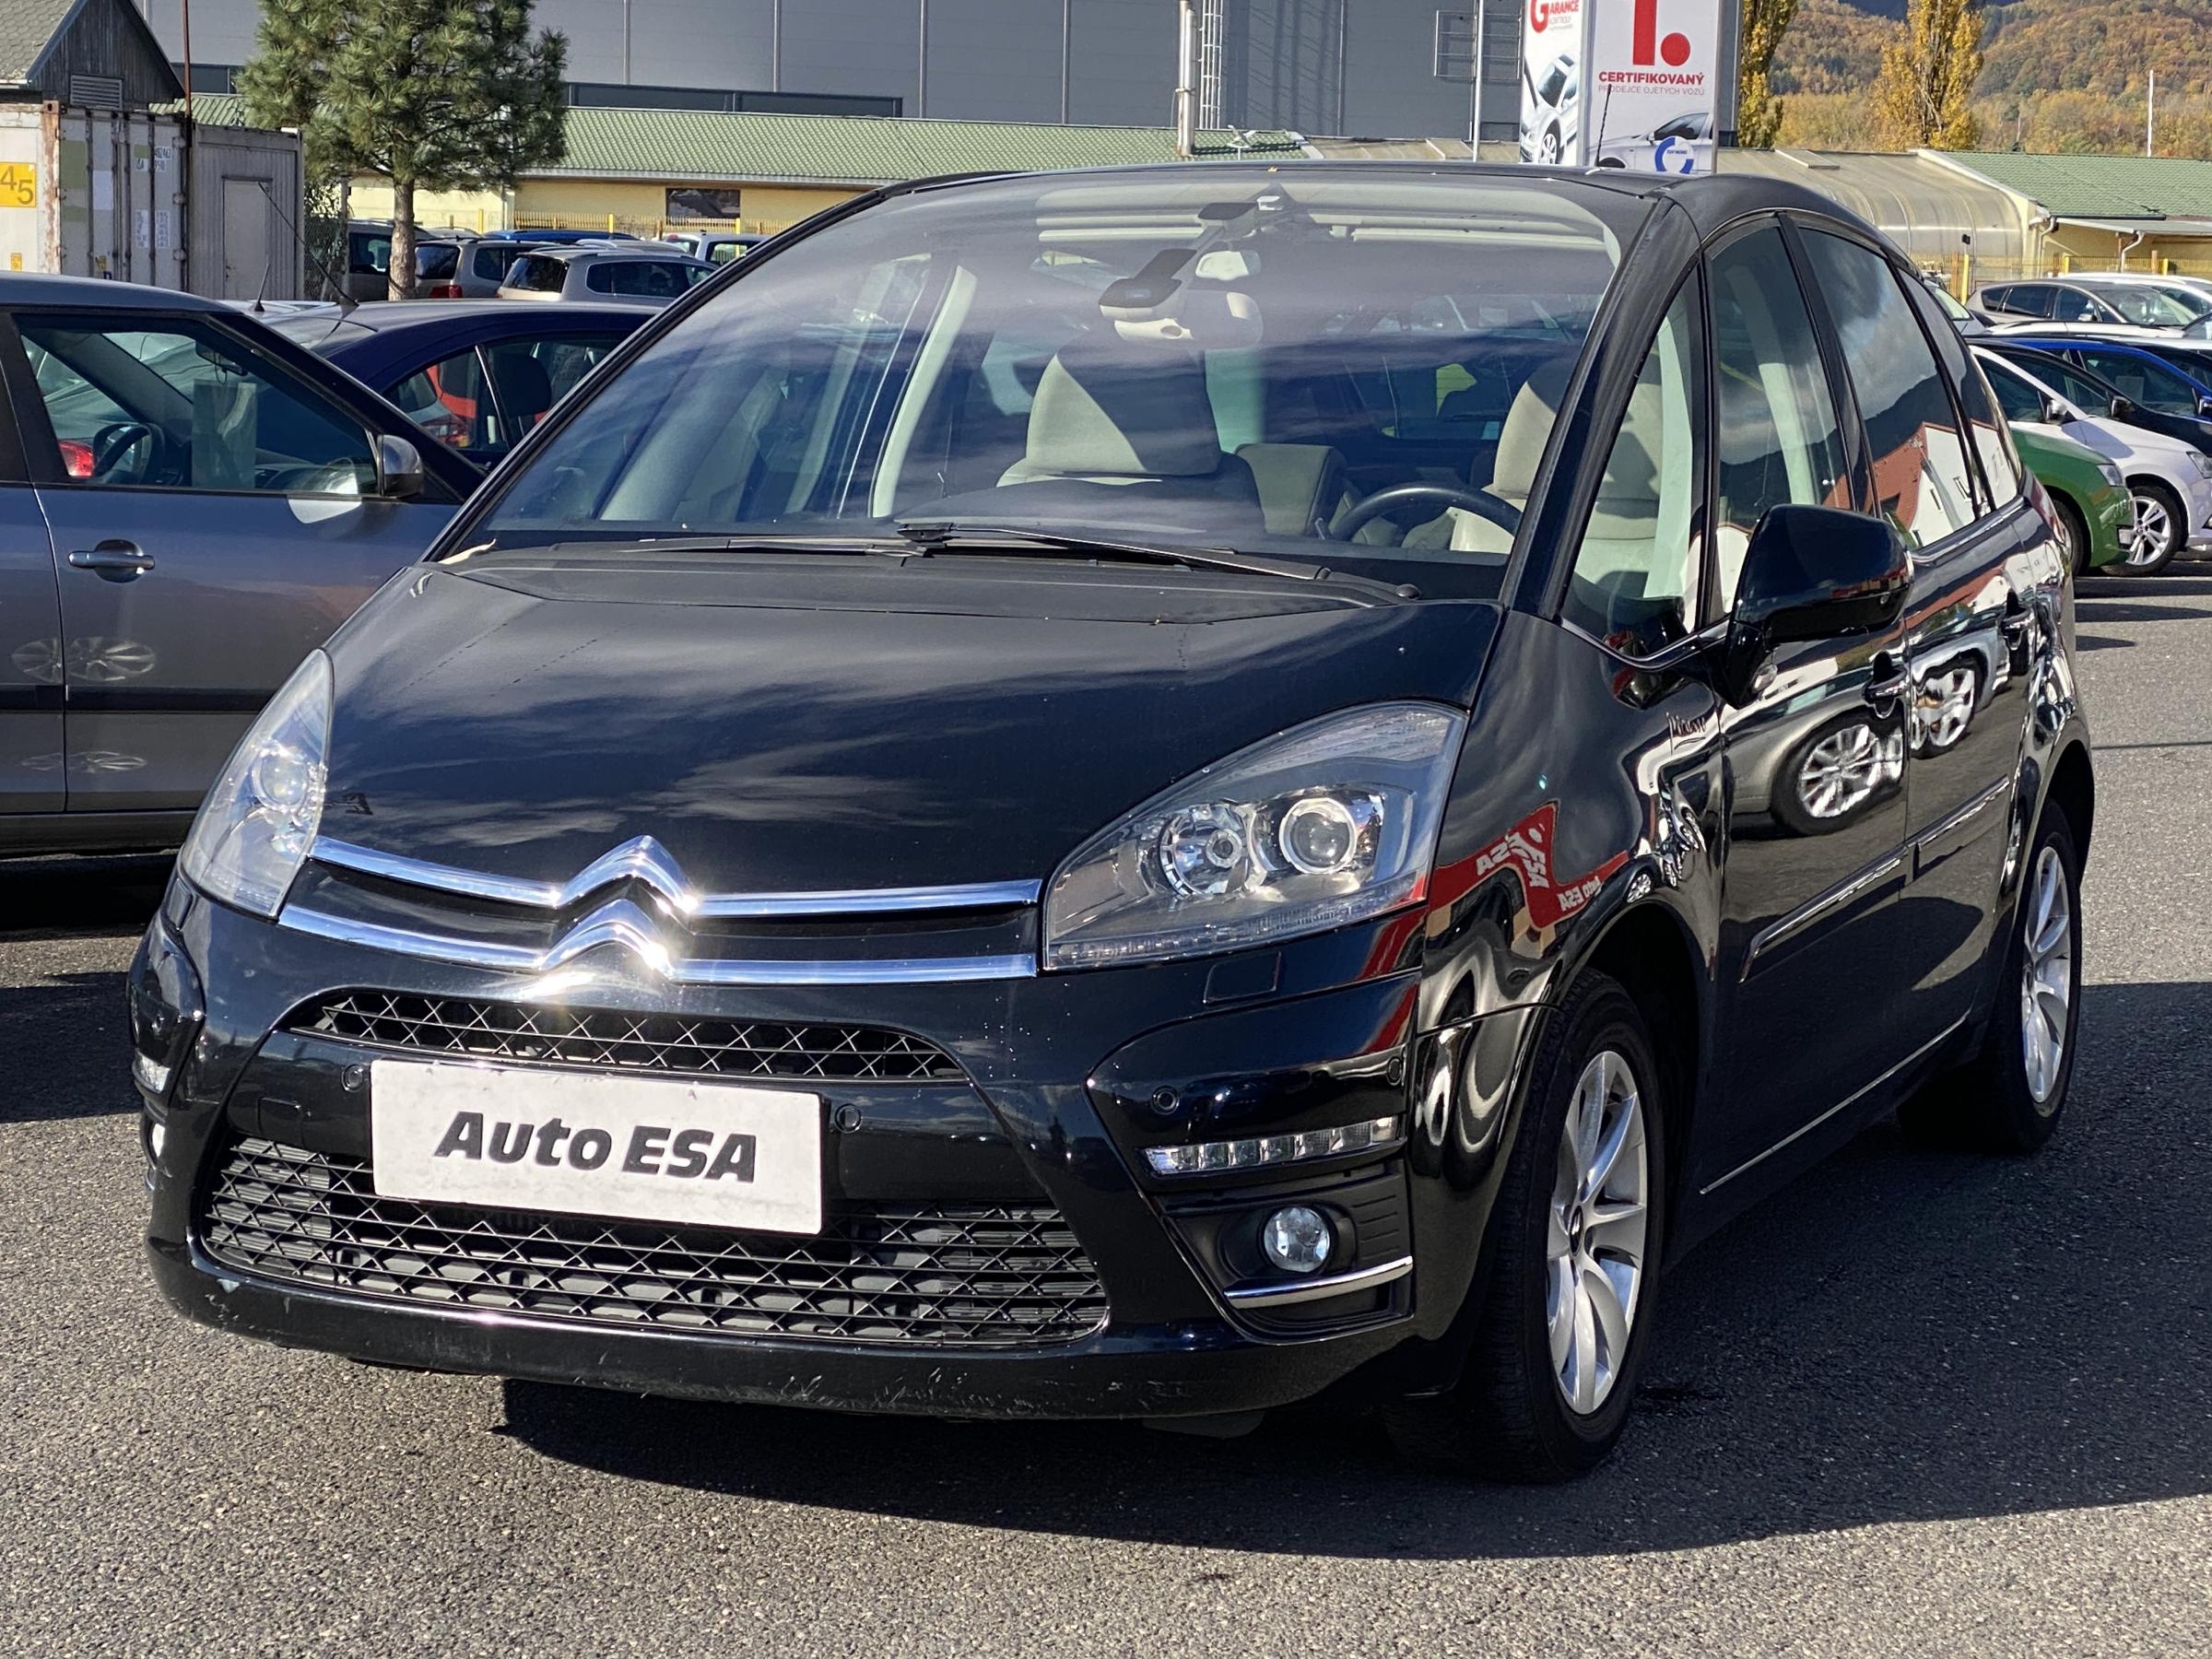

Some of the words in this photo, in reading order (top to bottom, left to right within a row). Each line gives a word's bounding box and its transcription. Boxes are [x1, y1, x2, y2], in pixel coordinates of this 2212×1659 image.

[1599, 72, 1704, 85] CERTIFIKOVANÝ
[433, 1111, 612, 1171] Auto
[621, 1124, 757, 1183] ESA
